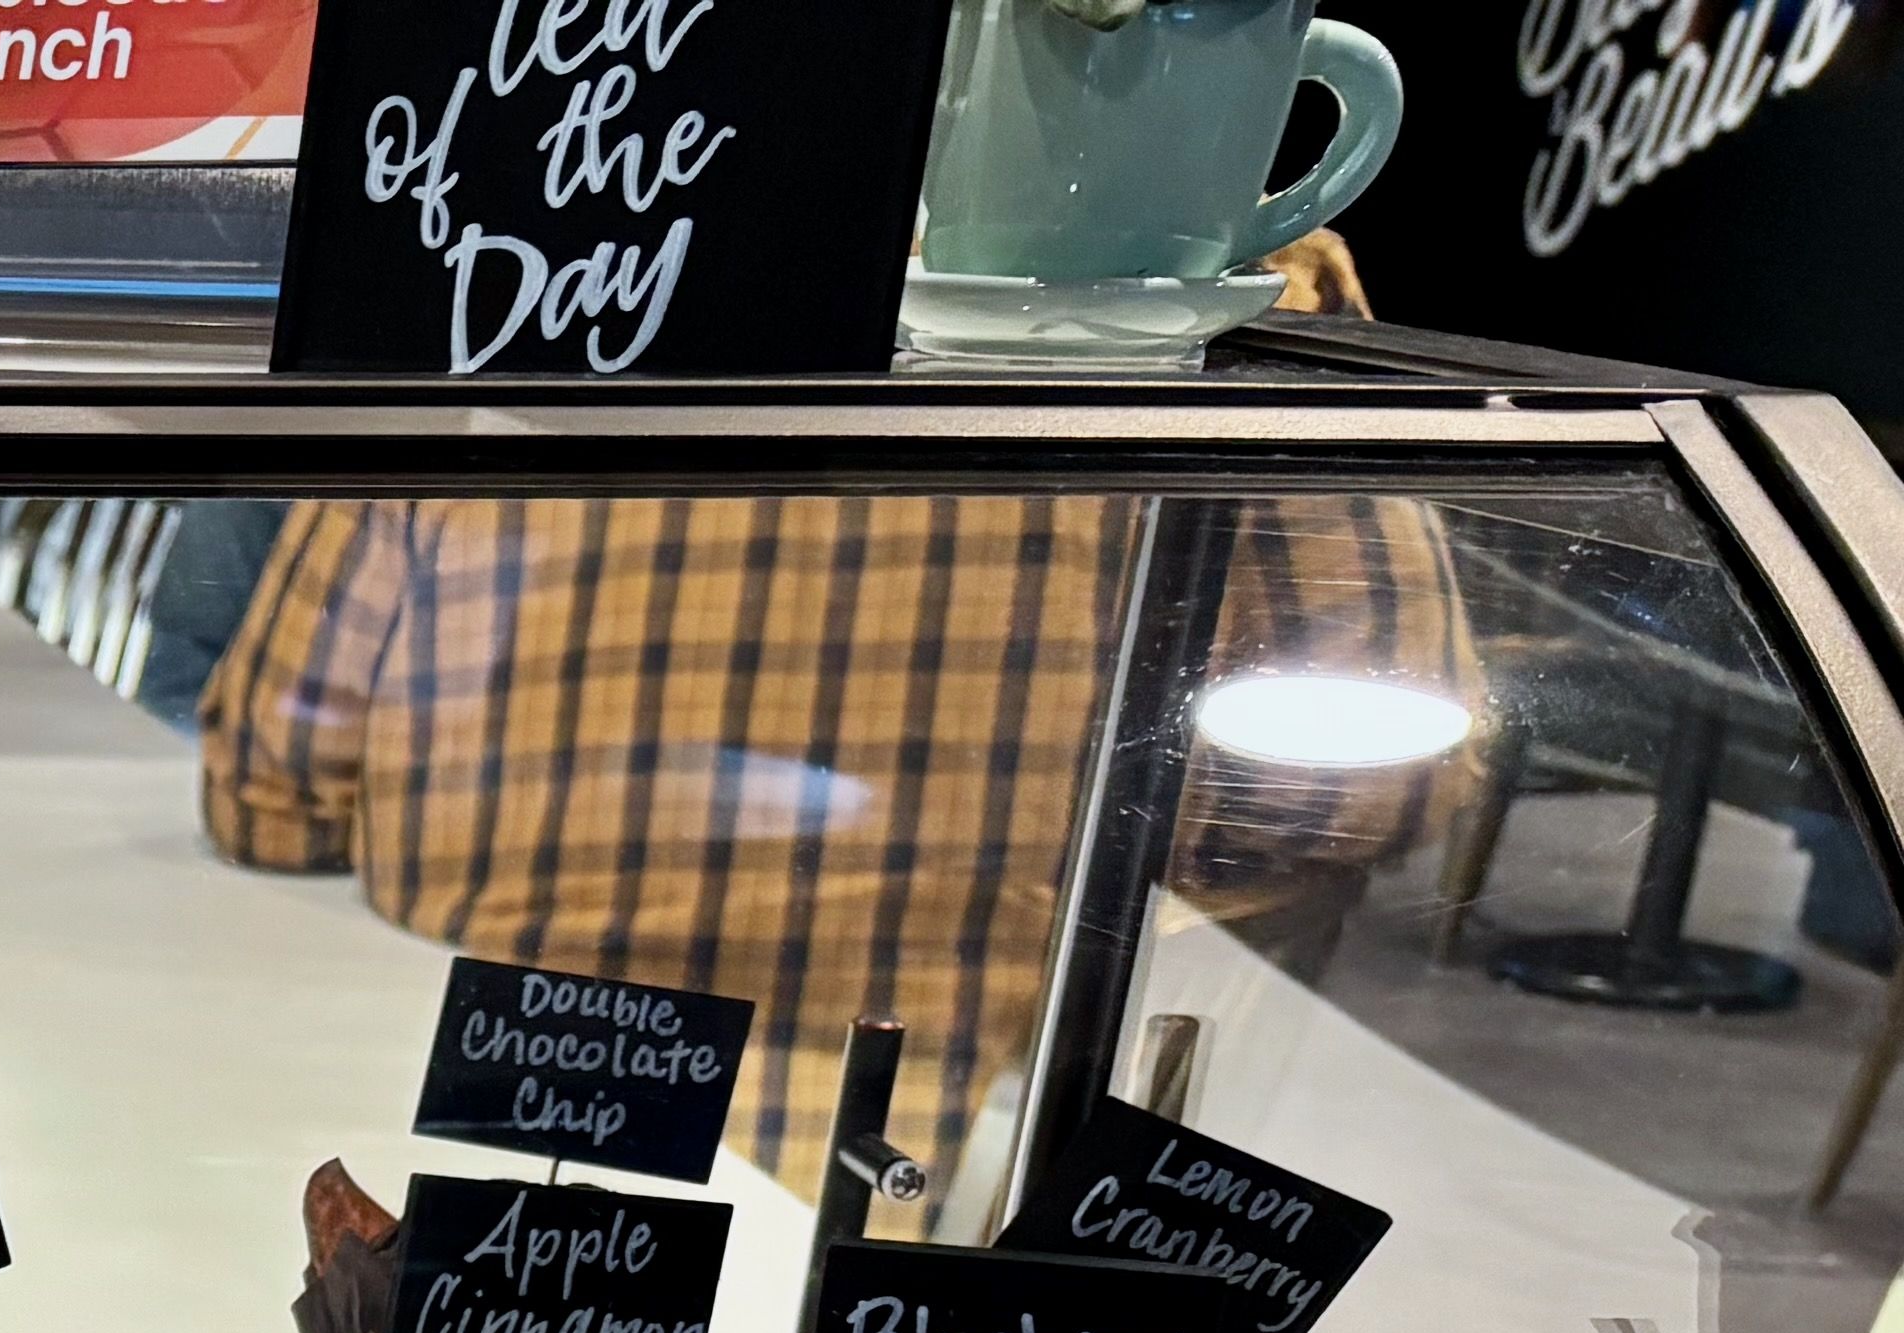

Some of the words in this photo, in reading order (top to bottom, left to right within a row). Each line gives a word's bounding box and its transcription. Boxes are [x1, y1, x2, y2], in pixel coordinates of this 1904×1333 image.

[537, 64, 737, 213] the
[443, 218, 693, 374] Day
[460, 1009, 723, 1085] Chocolate
[520, 973, 683, 1037] Double
[512, 1076, 627, 1146] Chip
[1146, 1137, 1314, 1243] Lemon
[463, 1190, 658, 1301] Apple
